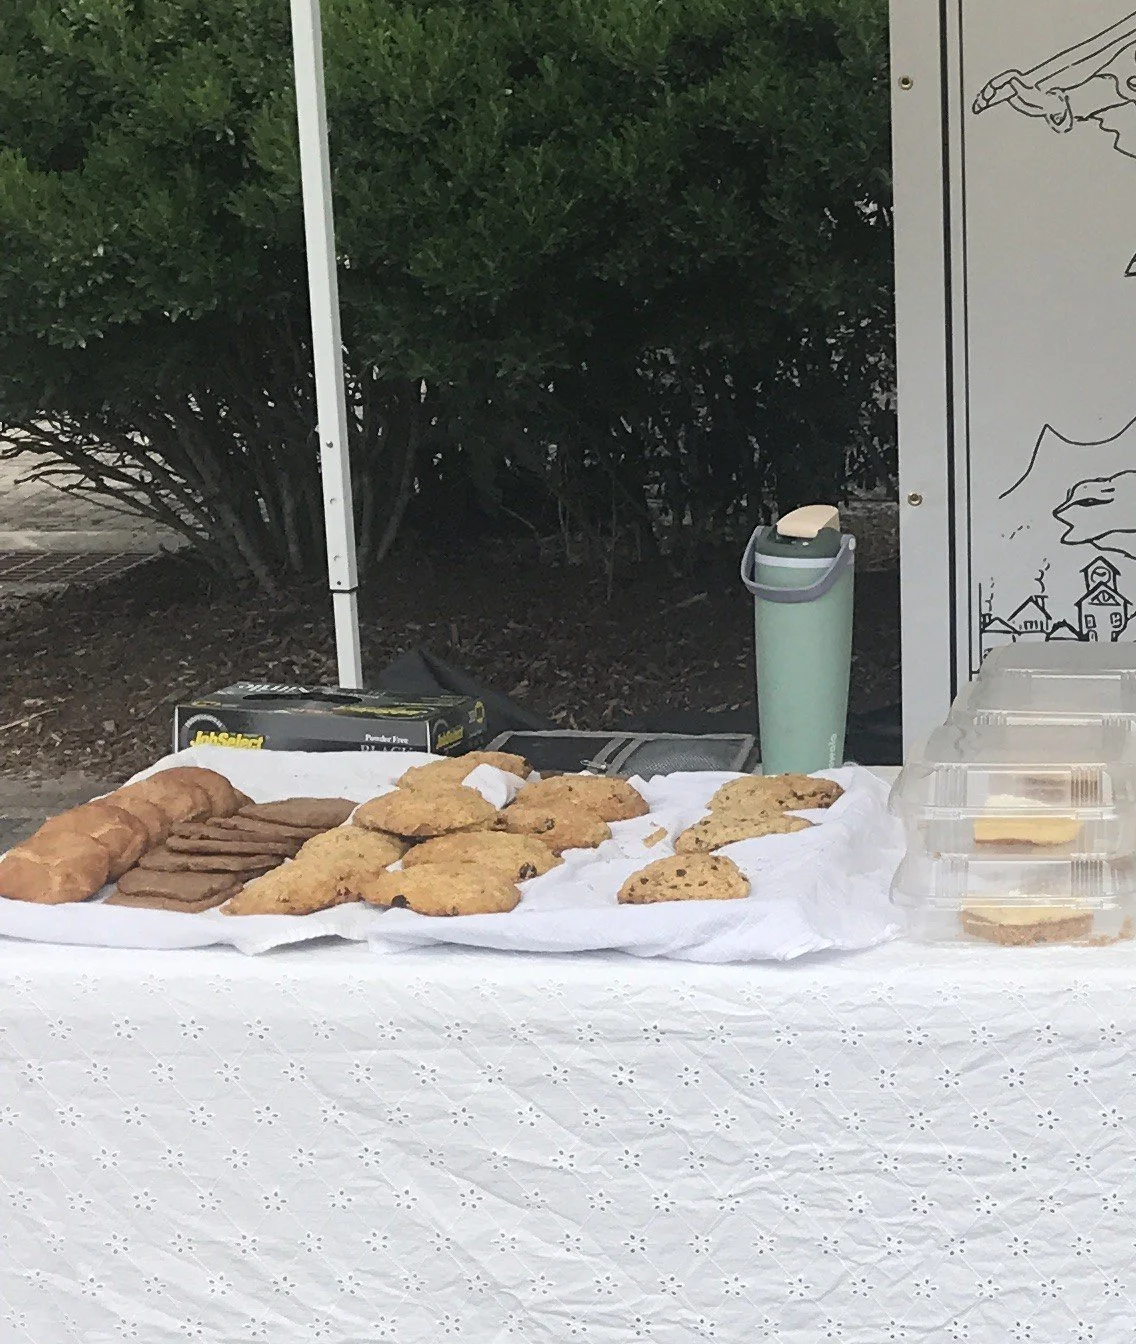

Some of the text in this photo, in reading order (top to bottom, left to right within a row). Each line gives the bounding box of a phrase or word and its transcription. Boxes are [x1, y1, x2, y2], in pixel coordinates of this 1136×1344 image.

[190, 730, 264, 749] JobSelect
[365, 733, 409, 745] Powder Free
